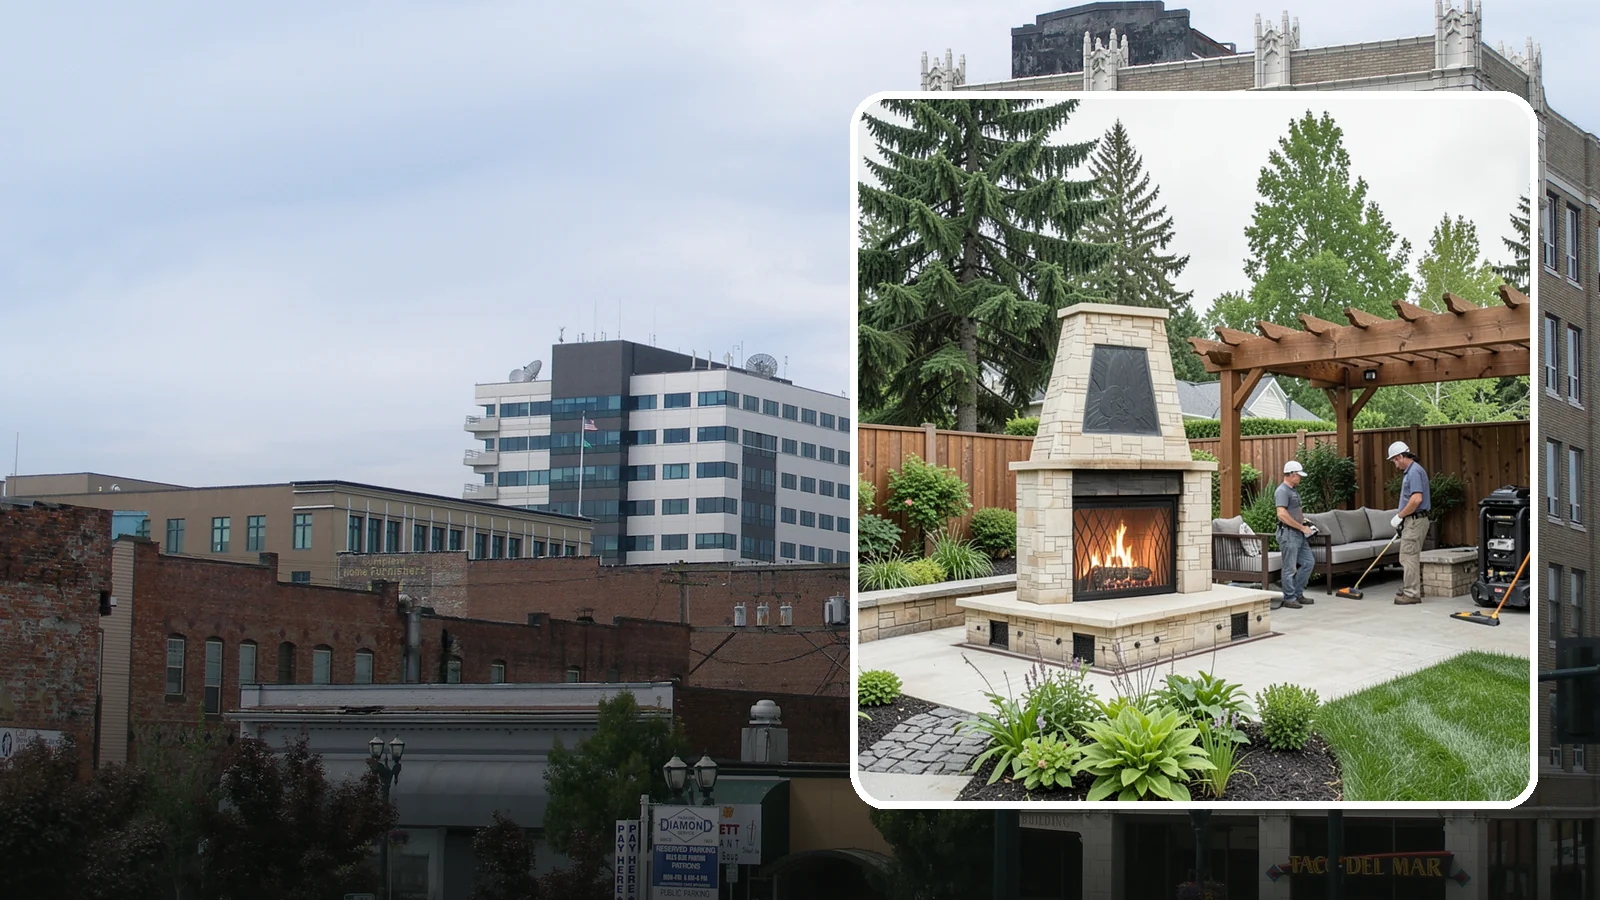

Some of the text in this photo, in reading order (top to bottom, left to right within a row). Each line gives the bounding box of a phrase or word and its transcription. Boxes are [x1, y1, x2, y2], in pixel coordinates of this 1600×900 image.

[343, 566, 427, 577] Home Furnishers
[660, 818, 713, 833] DIAMOND
[1022, 815, 1070, 827] BUILDING
[656, 845, 716, 854] RESERVED PARKING
[616, 824, 625, 894] PAY HERE
[627, 824, 637, 894] PAY HERE
[721, 851, 739, 862] Soup
[671, 862, 701, 870] PATRONS
[1346, 857, 1385, 875] DEL
[1392, 857, 1443, 877] MAR
[660, 889, 710, 898] PUBLIC PARKING
